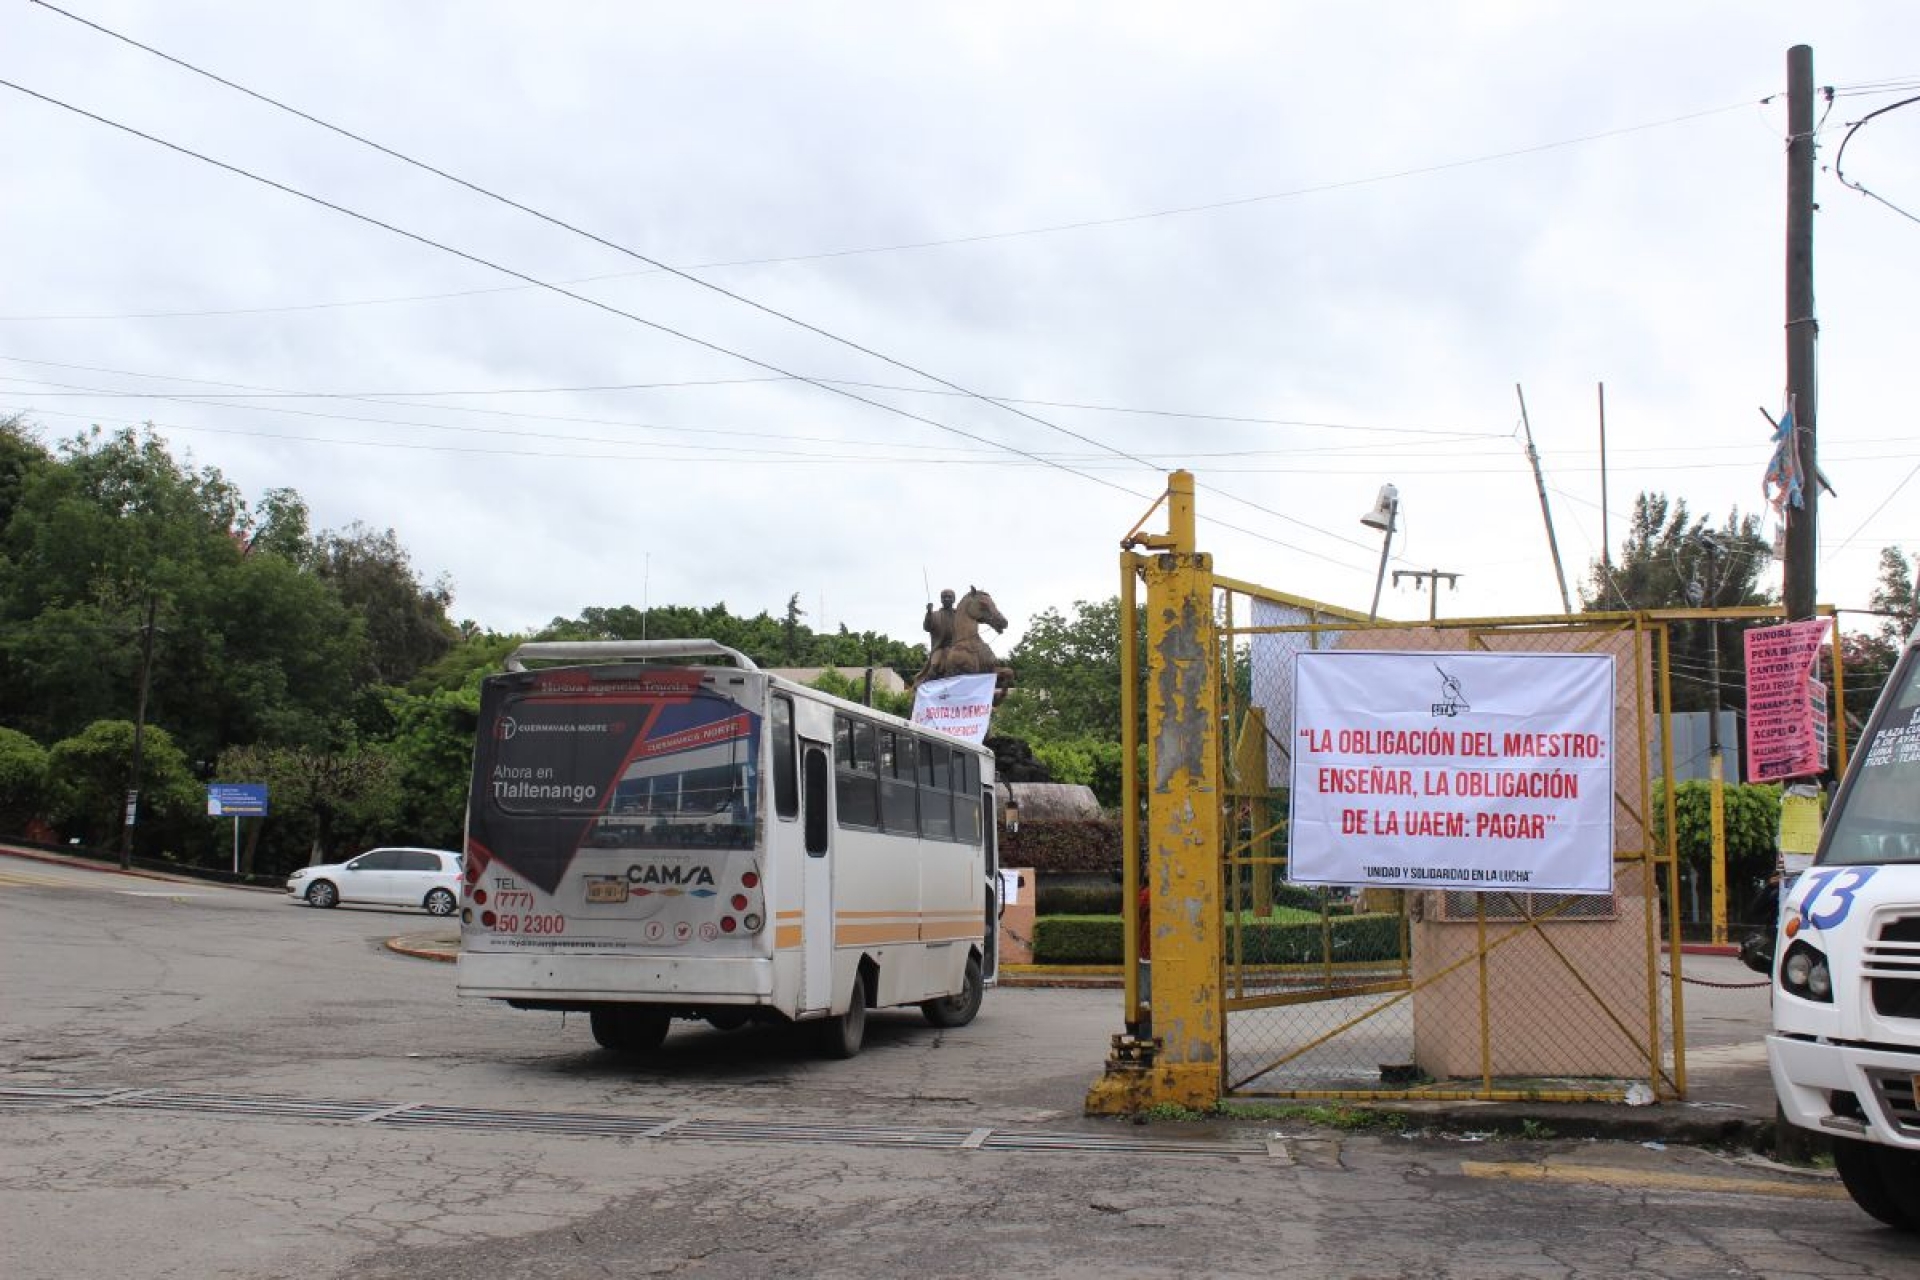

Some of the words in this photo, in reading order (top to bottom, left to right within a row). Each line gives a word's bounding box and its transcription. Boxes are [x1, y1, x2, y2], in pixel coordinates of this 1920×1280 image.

[518, 724, 576, 732] CUERNAVACA
[577, 724, 608, 732] NORTE
[702, 722, 740, 739] NORTE
[1338, 726, 1455, 756] OBLIGACIÓN
[1460, 732, 1498, 757] DEL
[1503, 732, 1606, 759] MAESTRO:
[493, 764, 533, 779] Ahora
[536, 767, 553, 779] en
[1318, 765, 1418, 799] ENSEÑAR,
[1424, 771, 1449, 796] LA
[1455, 768, 1579, 799] OBLIGACIÓN
[493, 781, 597, 803] Tlaltenango
[1341, 808, 1369, 835] DE
[1373, 810, 1399, 836] LA
[1404, 811, 1470, 838] UAEM:
[626, 863, 716, 886] CAMSA
[1402, 866, 1409, 879] Y
[1410, 867, 1470, 881] SOLIDARIDAD
[1471, 868, 1484, 881] EN
[1485, 868, 1497, 882] LA
[493, 892, 535, 912] (777)
[1799, 866, 1879, 931] 13
[523, 914, 564, 934] 2300
